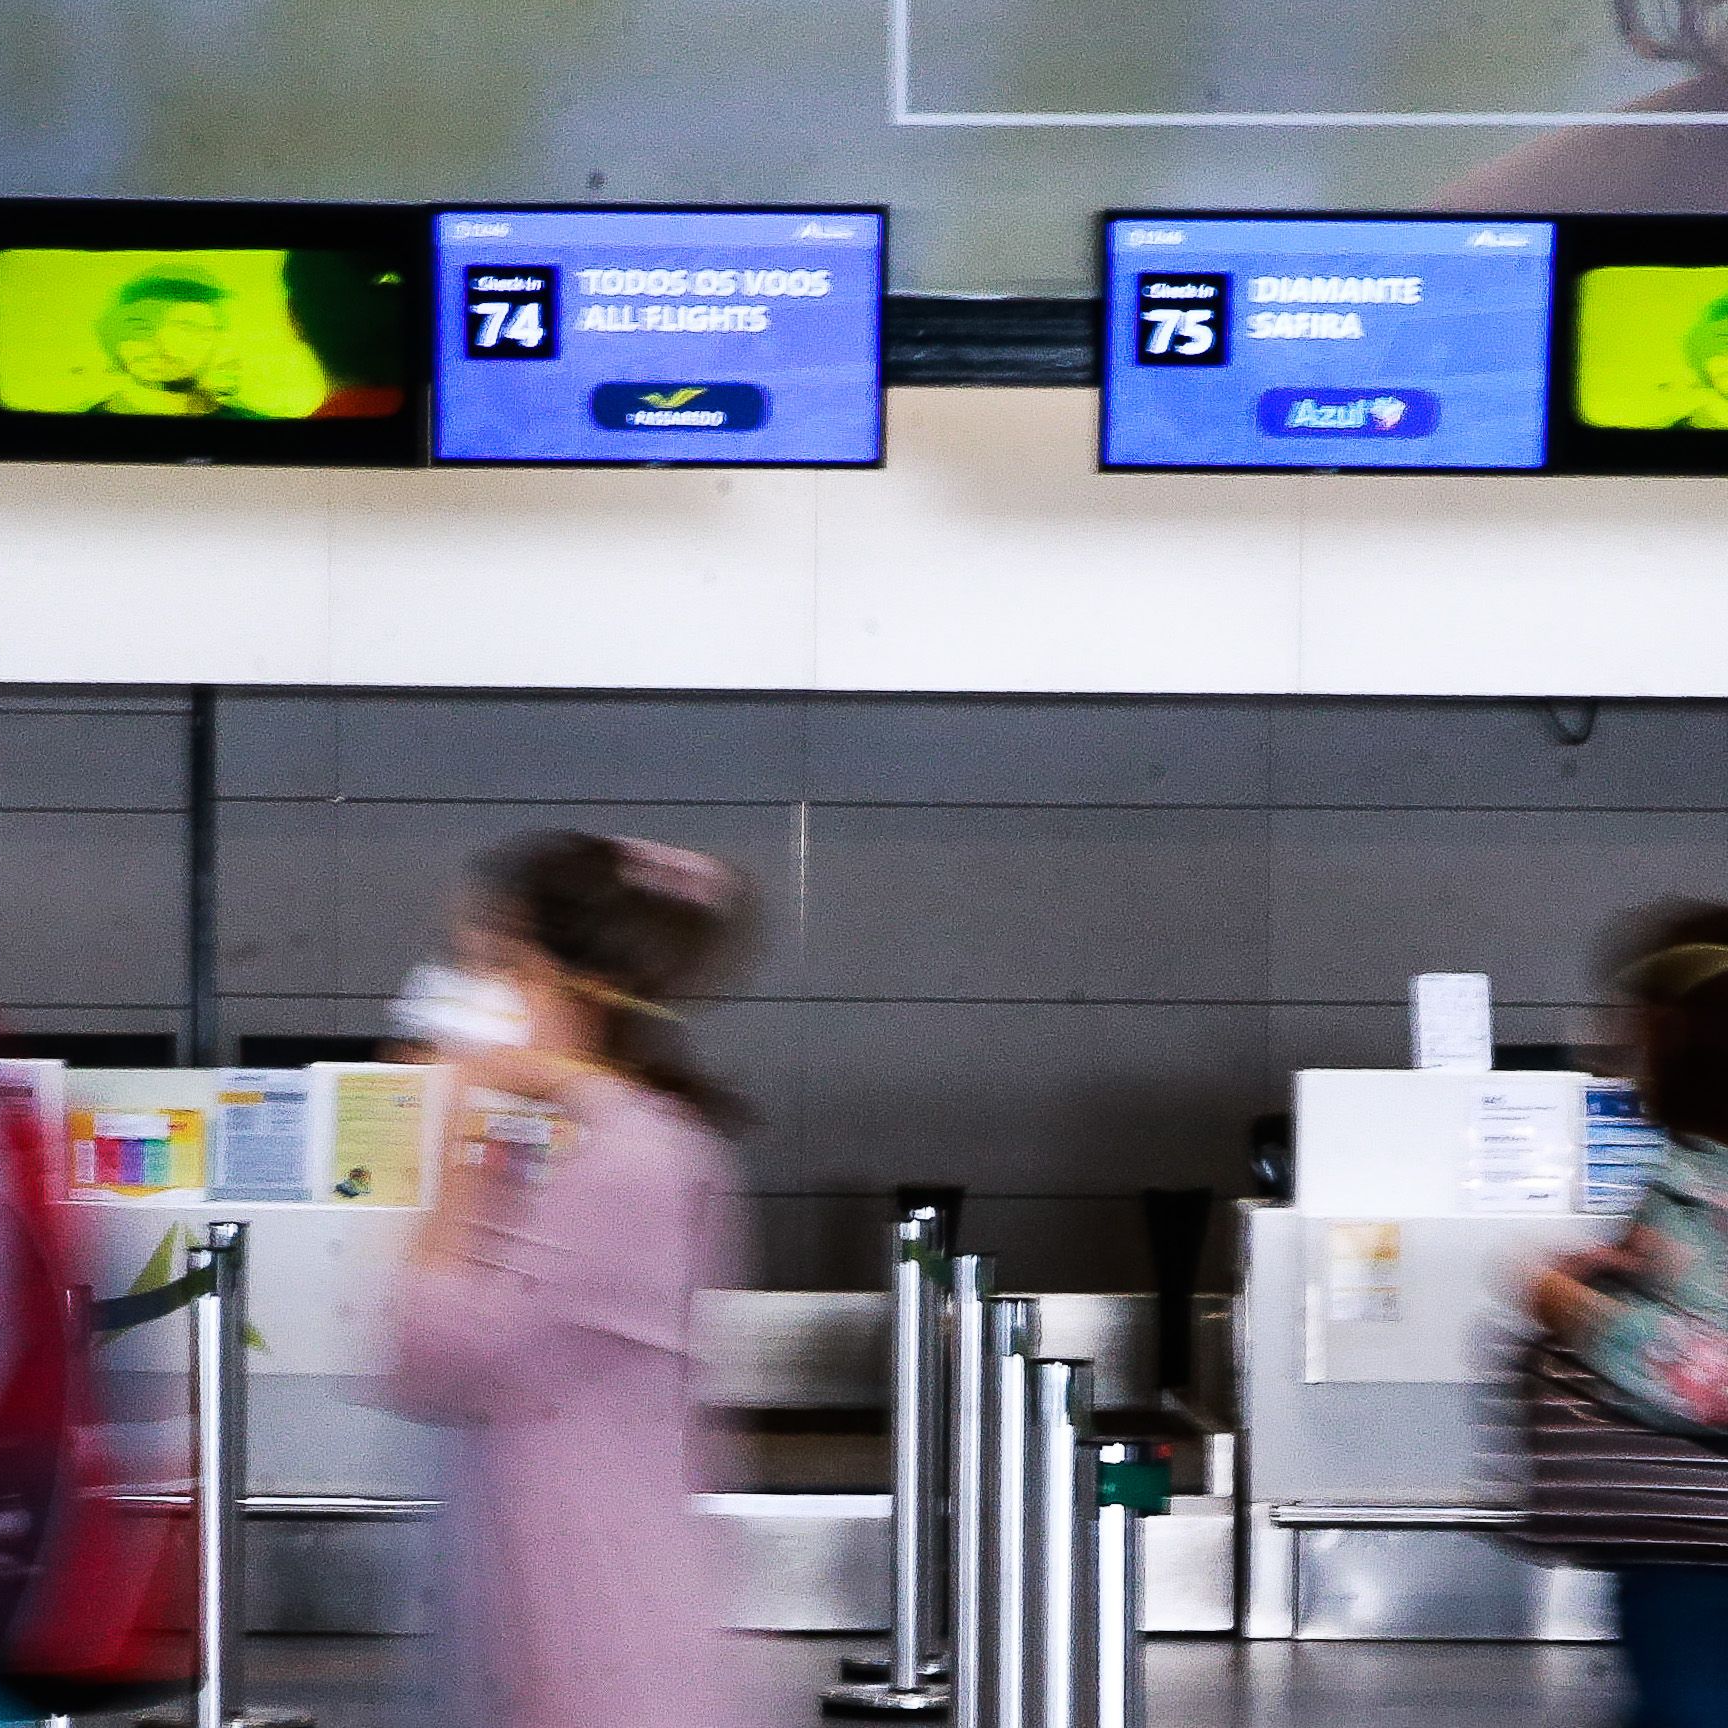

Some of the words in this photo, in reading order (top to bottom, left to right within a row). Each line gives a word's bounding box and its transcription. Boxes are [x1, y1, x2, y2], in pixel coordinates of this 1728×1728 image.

[578, 269, 688, 296] TODOS
[694, 270, 736, 295] OS
[742, 270, 831, 297] VOOS
[1248, 277, 1423, 303] DIAMANTE
[470, 302, 545, 347] 74
[580, 305, 639, 331] ALL
[641, 305, 770, 332] FLIGHTS
[1140, 309, 1216, 355] 75
[1248, 312, 1364, 339] SAFIRA
[1284, 397, 1371, 428] Azul
